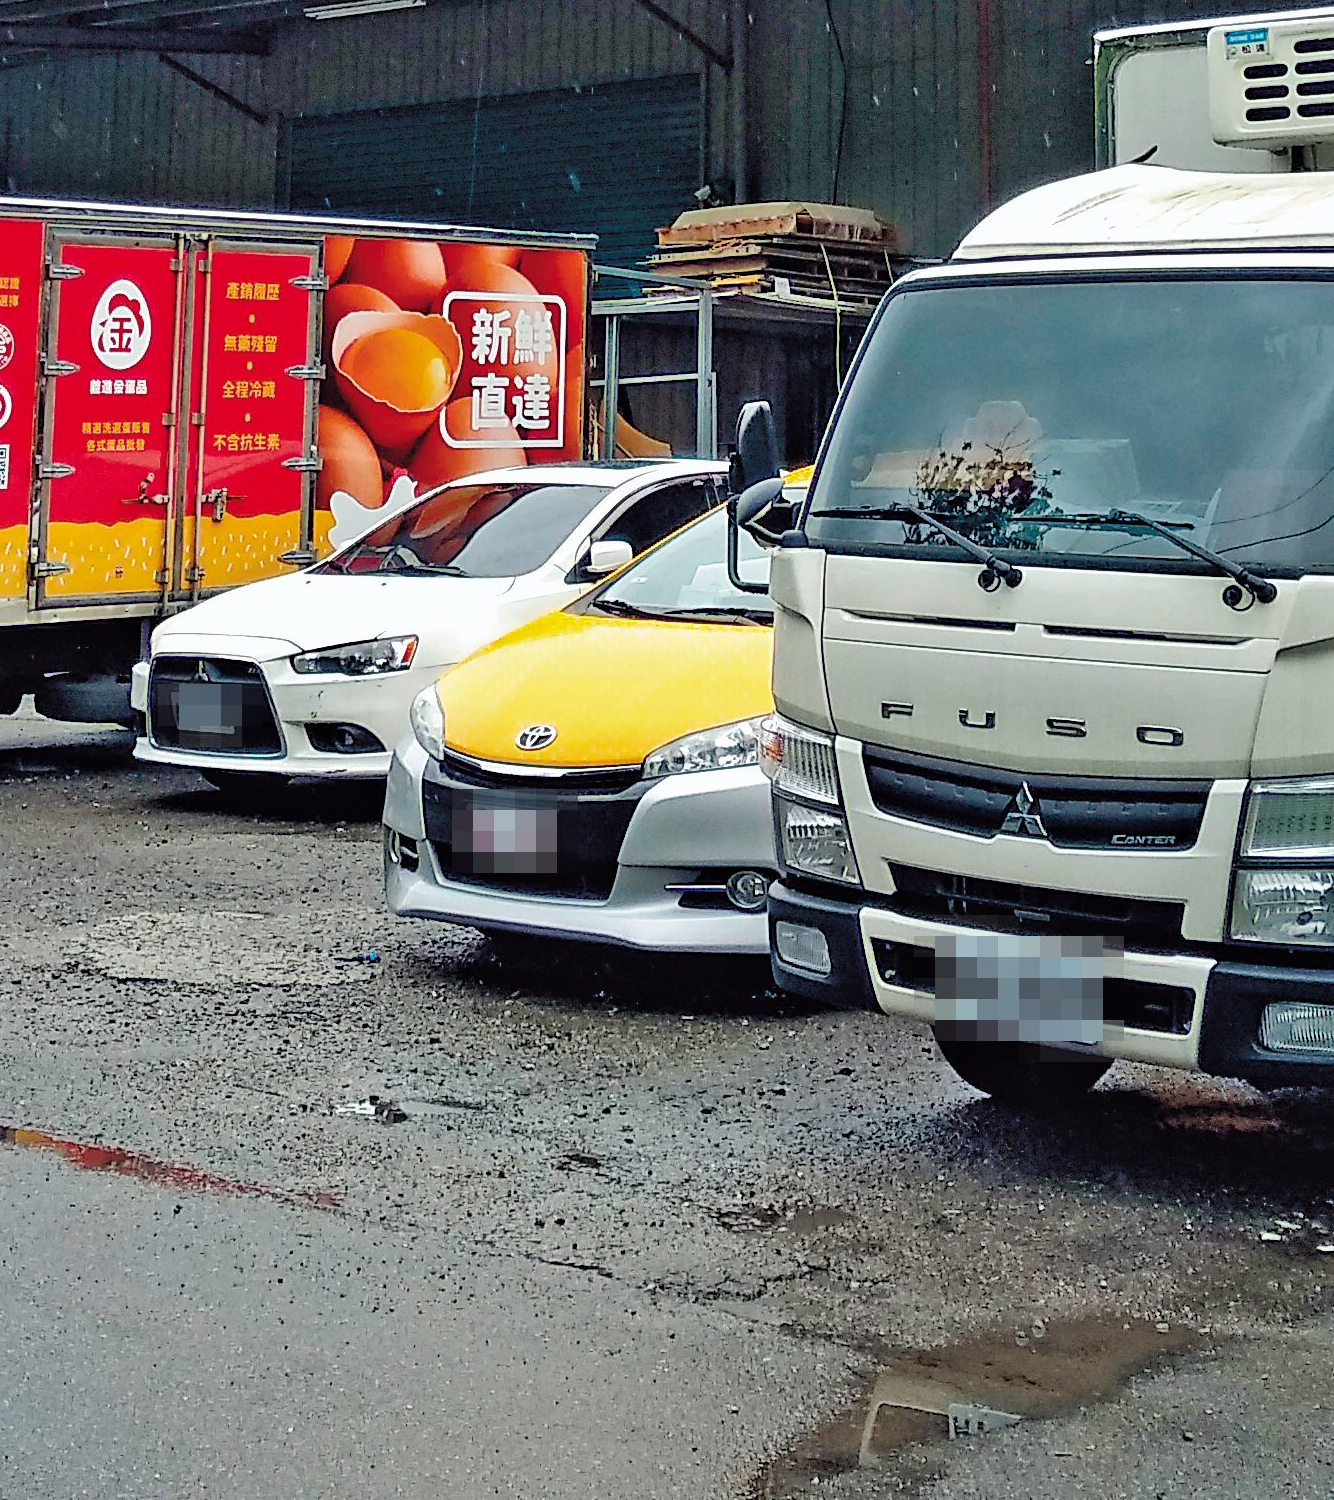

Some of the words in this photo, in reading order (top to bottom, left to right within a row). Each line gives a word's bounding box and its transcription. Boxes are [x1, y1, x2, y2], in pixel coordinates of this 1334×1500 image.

[471, 307, 553, 366] 新鮮
[222, 380, 276, 399] 全程冷藏
[471, 372, 551, 431] 直達
[212, 432, 281, 452] 不含抗生素
[880, 699, 1185, 747] FUSO
[1110, 833, 1178, 846] CANTER
